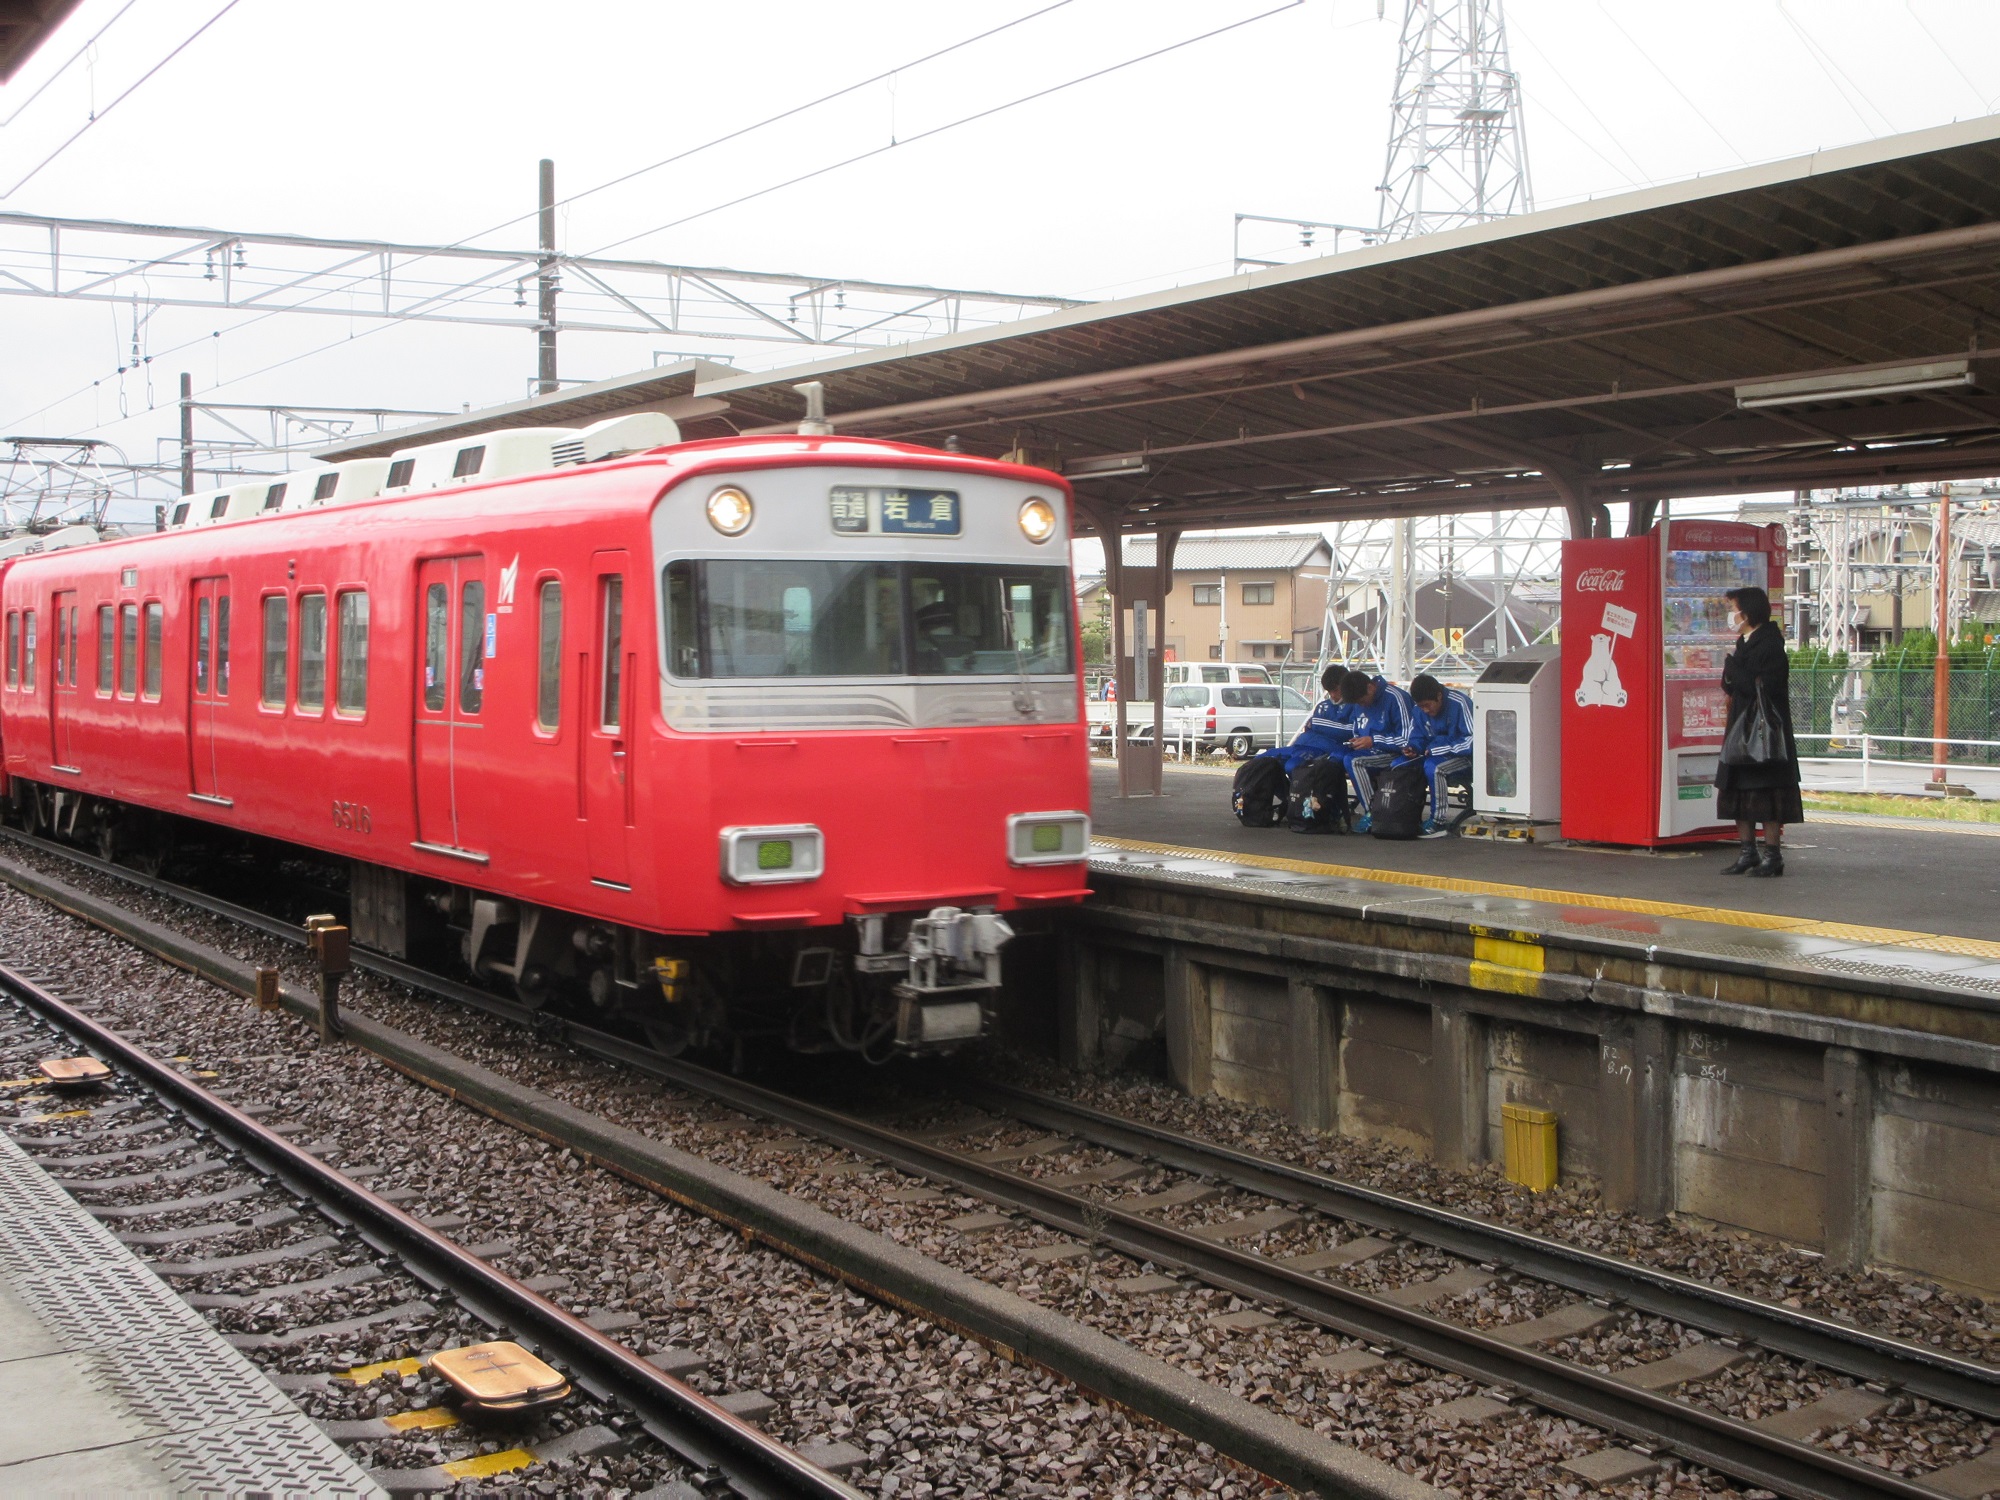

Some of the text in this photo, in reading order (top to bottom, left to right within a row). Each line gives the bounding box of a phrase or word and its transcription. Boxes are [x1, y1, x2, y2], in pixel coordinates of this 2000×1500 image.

[830, 492, 866, 519] 普通
[884, 493, 954, 521] 岩倉
[1576, 569, 1625, 592] Coca-Cola
[333, 800, 371, 834] 6516
